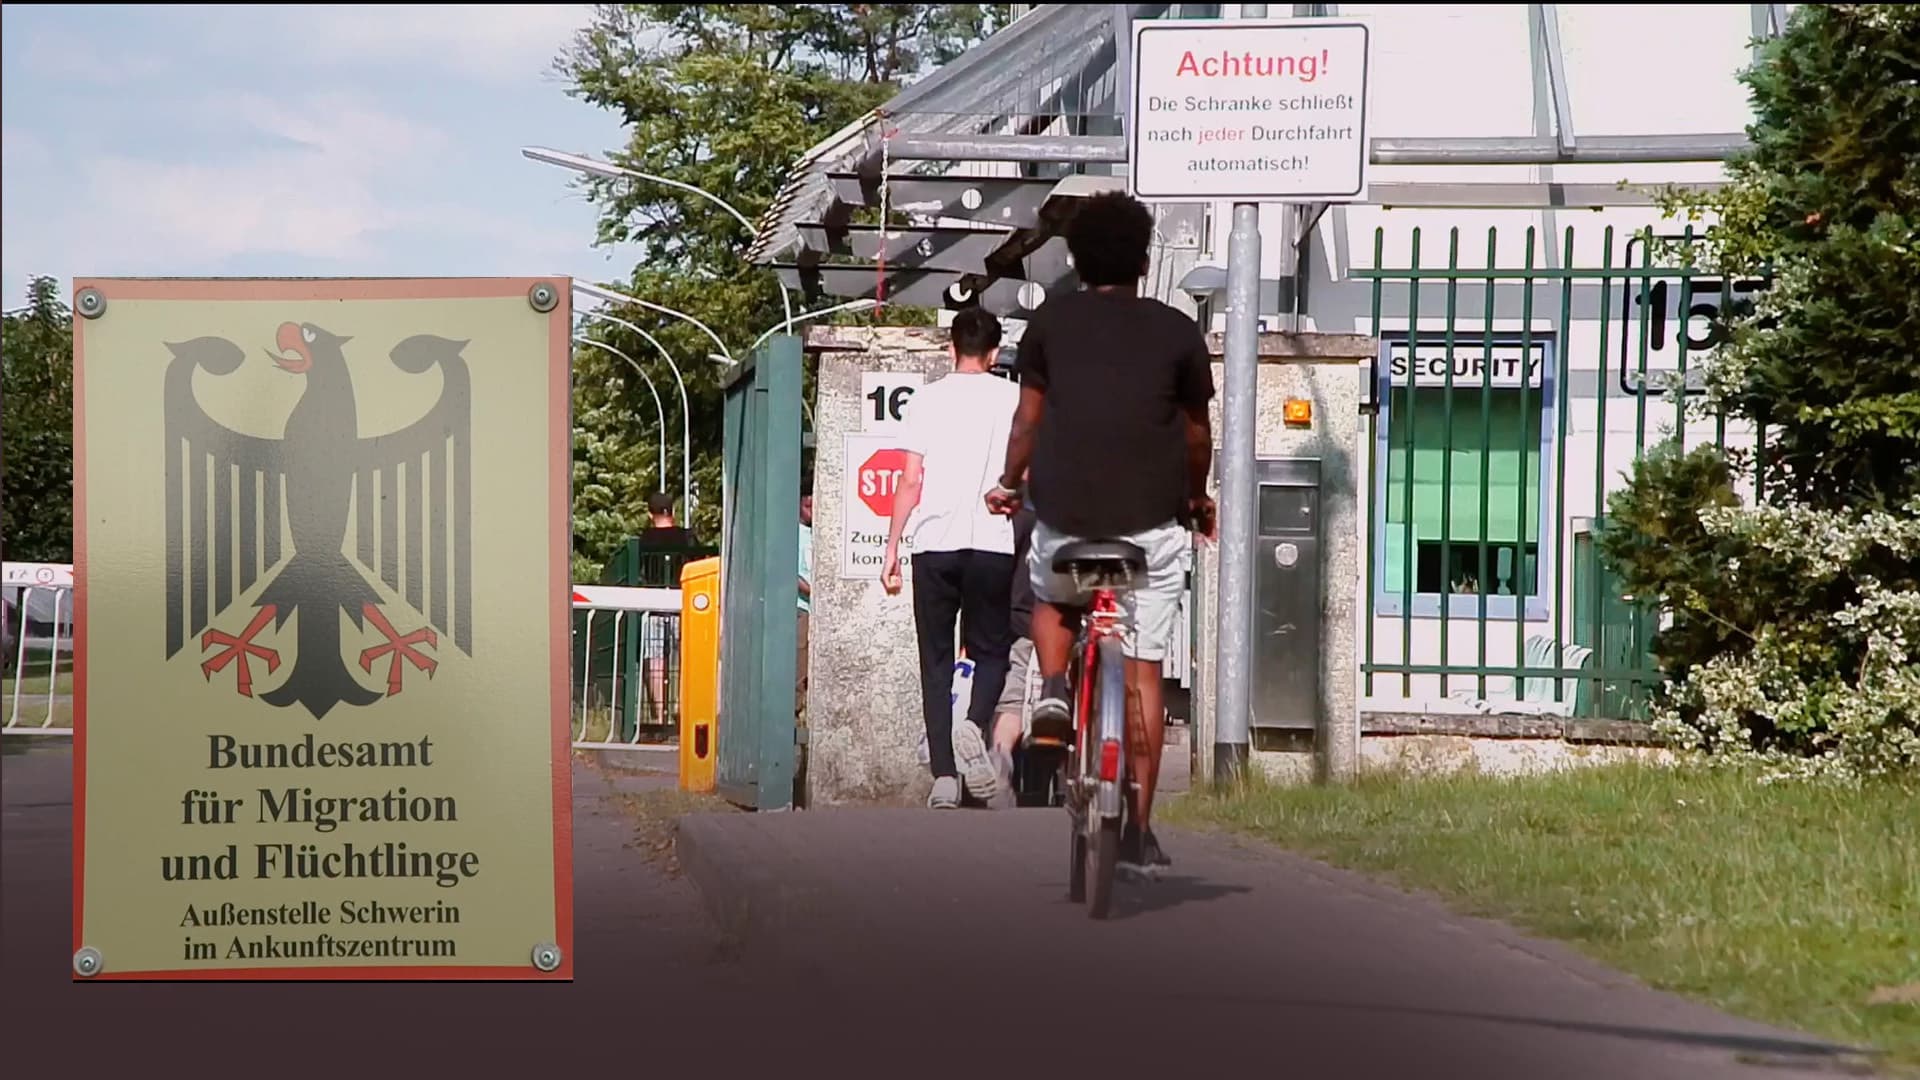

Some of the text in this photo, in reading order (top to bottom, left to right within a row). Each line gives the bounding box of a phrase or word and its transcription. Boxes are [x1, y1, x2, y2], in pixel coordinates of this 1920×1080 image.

[1176, 49, 1329, 82] Achtung!
[1148, 94, 1354, 112] Die Schranke schließt
[1148, 124, 1353, 145] nach jeder Durchfahrt
[1187, 156, 1309, 171] automatisch!
[1391, 356, 1540, 377] SECURITY
[207, 733, 434, 769] Bundesamt
[181, 786, 458, 833] für Migration
[160, 842, 480, 888] und Flüchtlinge
[179, 899, 461, 928] Außenstelle Schwerin
[184, 933, 457, 961] im Ankunftszentrum
